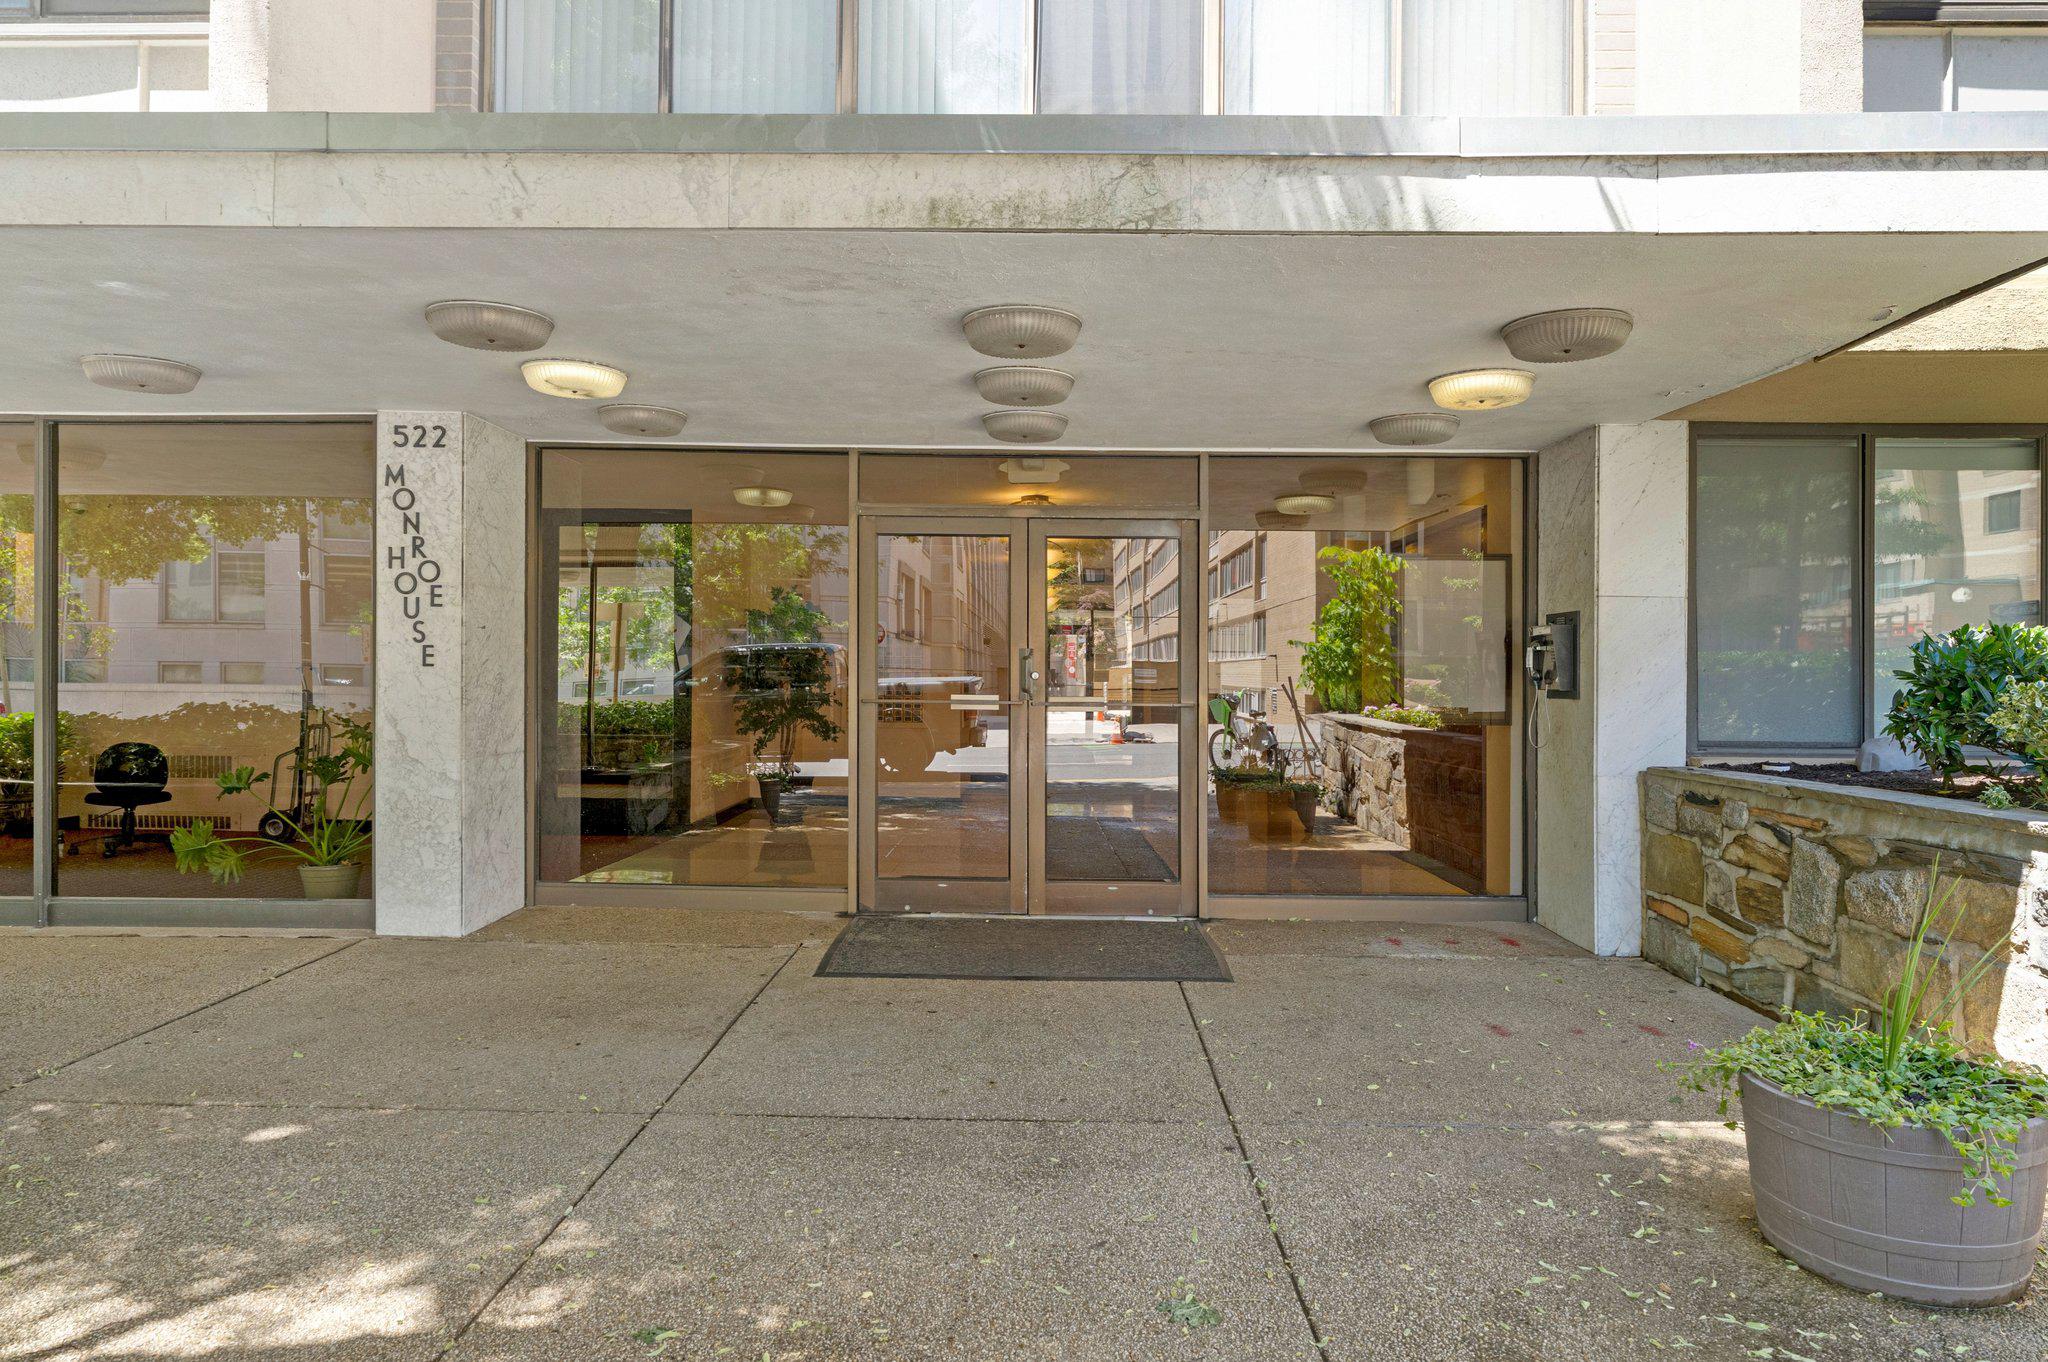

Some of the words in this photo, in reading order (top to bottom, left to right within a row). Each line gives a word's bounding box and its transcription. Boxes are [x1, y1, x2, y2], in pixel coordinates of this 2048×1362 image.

[392, 424, 448, 449] 522
[384, 463, 444, 608] MONROE
[387, 546, 436, 668] HOUSE
